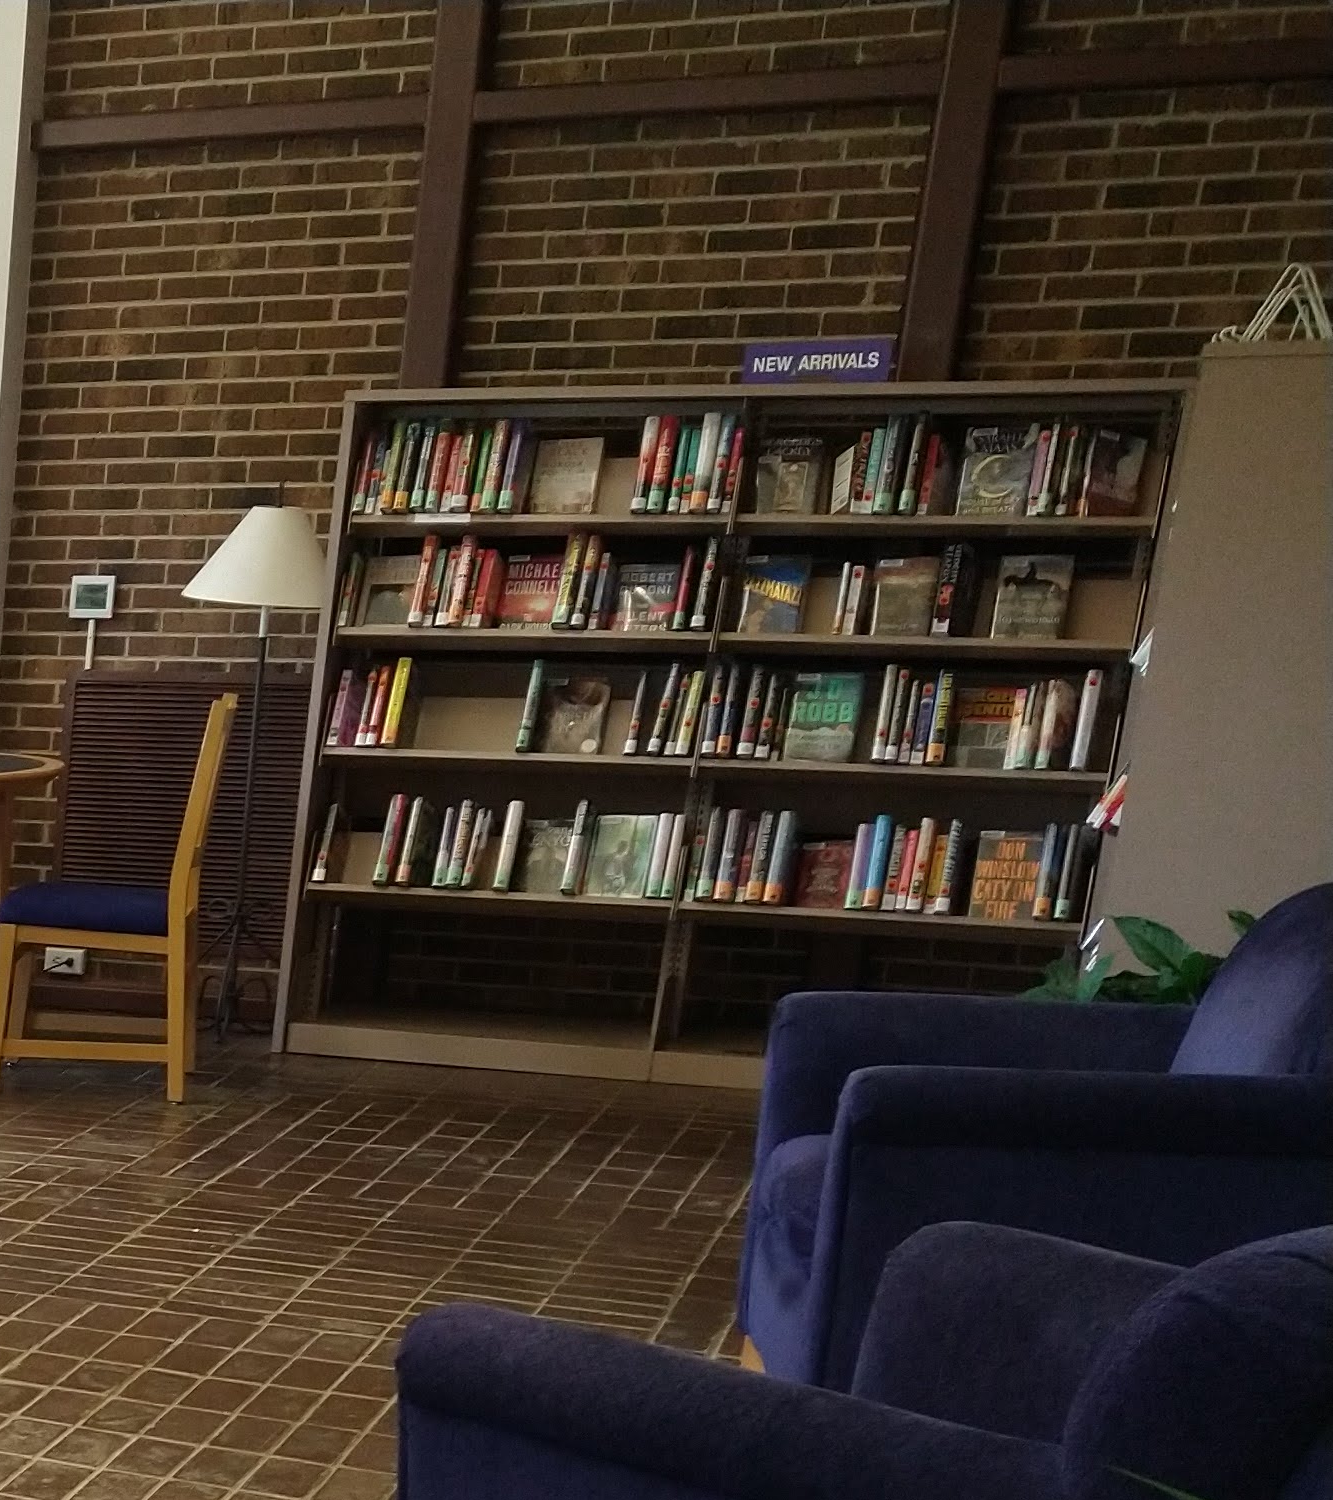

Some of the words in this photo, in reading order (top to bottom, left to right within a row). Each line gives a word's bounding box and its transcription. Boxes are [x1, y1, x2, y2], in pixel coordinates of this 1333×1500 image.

[753, 356, 793, 373] NEW
[798, 351, 880, 371] ARRIVALS
[508, 562, 562, 579] MICHAE
[796, 701, 854, 723] ROBB
[997, 840, 1027, 860] DON
[976, 859, 1041, 879] WINSLOW
[972, 878, 1013, 900] CITY
